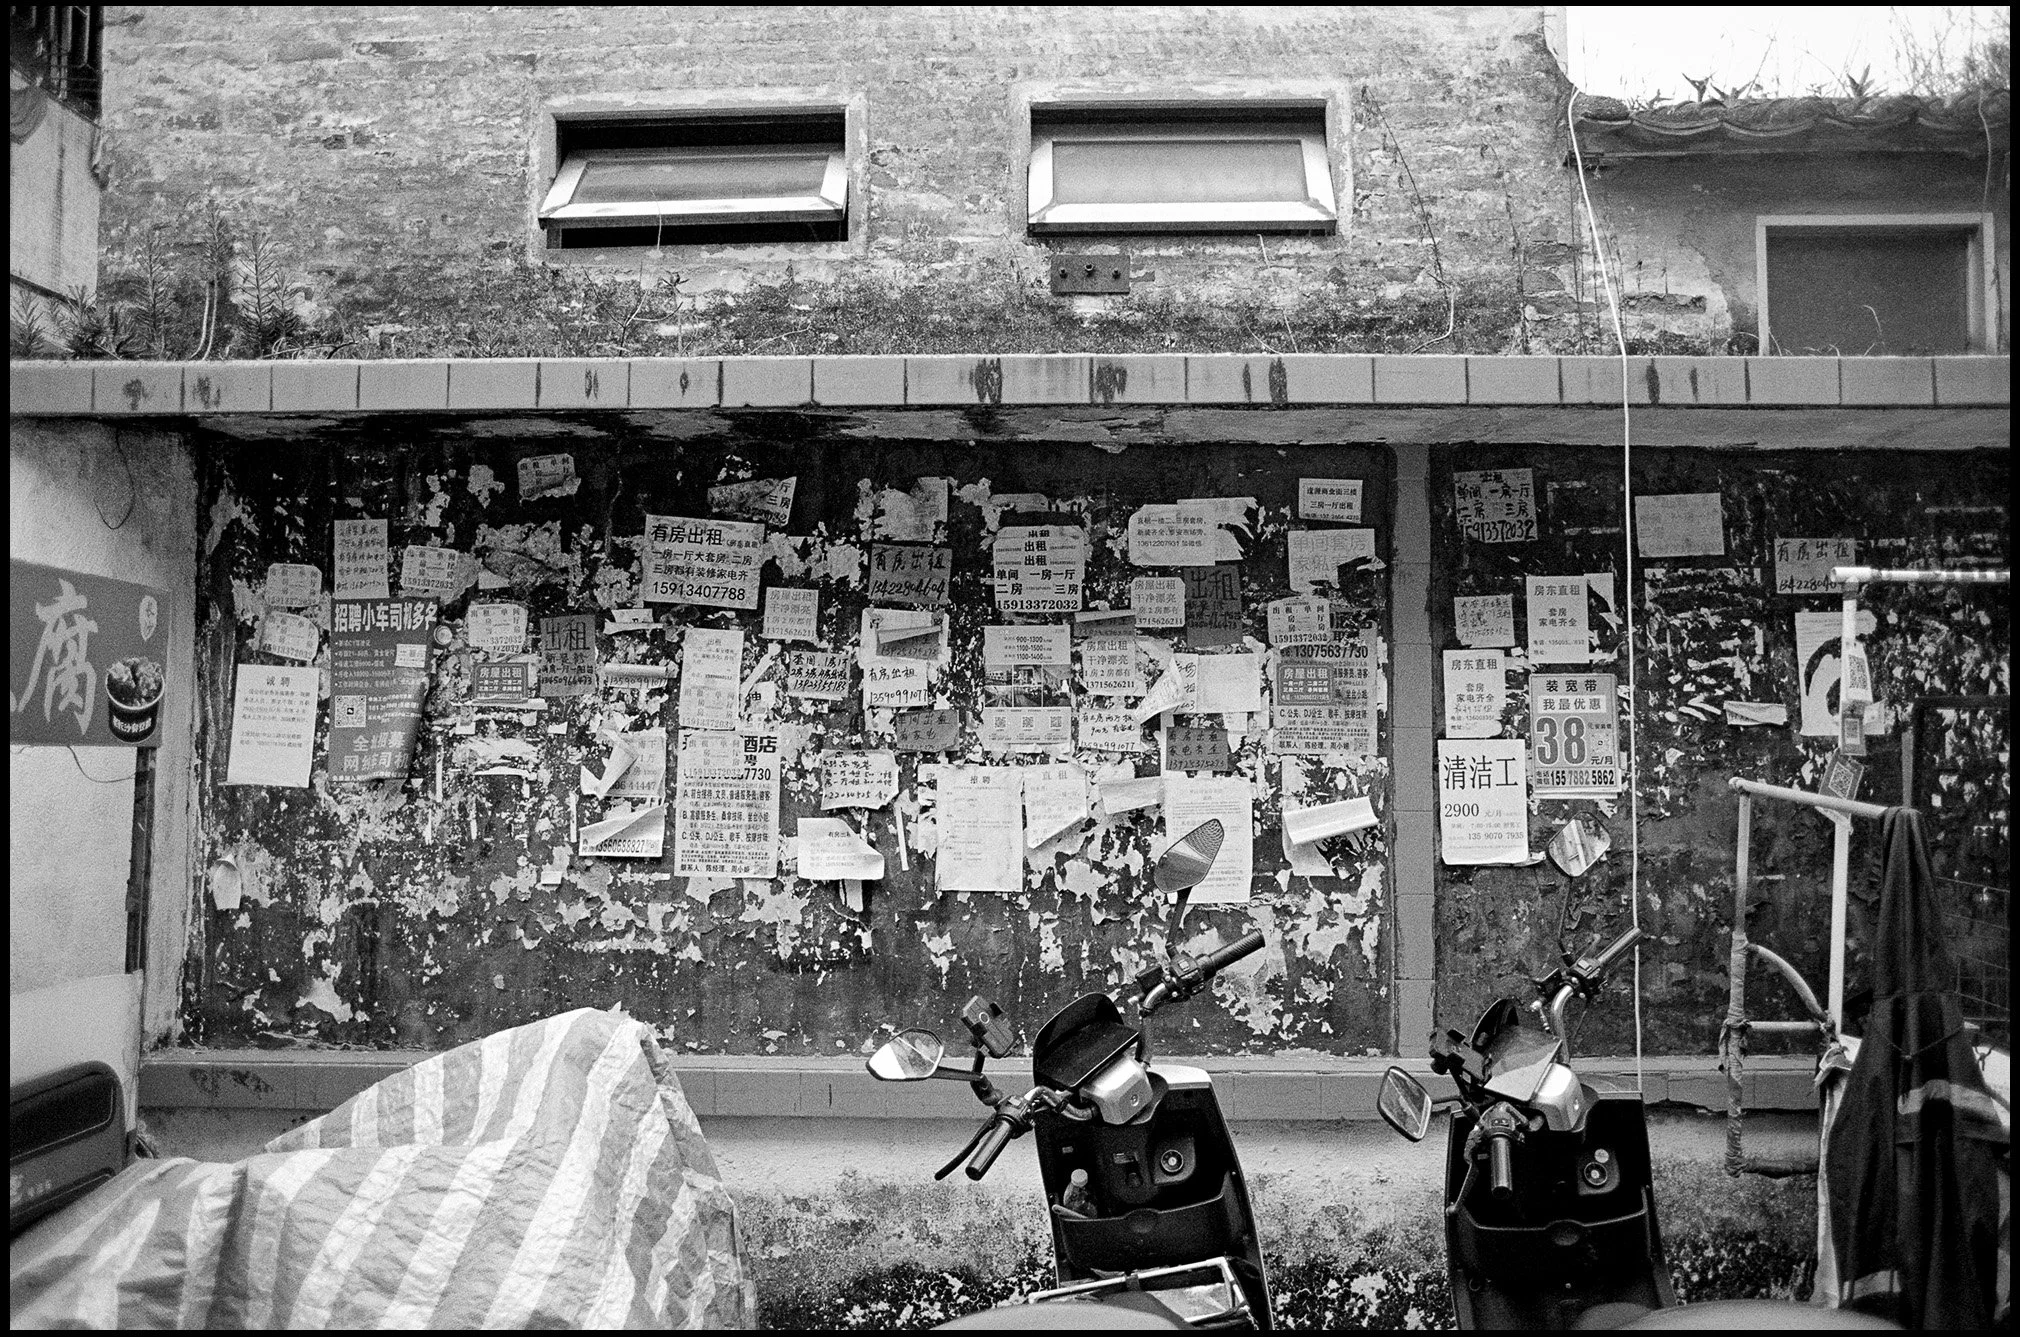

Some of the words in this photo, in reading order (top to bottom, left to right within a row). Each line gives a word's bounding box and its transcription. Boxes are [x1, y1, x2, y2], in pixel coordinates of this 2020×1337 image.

[651, 524, 723, 546] 有房出租
[1024, 541, 1047, 552] 出租
[652, 549, 727, 564] 一房一厅大套房
[732, 555, 752, 566] 二房
[1024, 555, 1047, 566] 出租
[653, 564, 749, 581] 三房都有装修家电齐
[996, 569, 1019, 580] 单间
[1029, 569, 1076, 580] 一房一厅
[996, 583, 1023, 595] 二房
[1054, 584, 1079, 595] 三房
[1135, 580, 1177, 590] 房屋出租
[1534, 585, 1581, 596] 房东直租
[652, 581, 747, 601] 15913407788
[996, 600, 1079, 610] 15913372032
[334, 602, 438, 632] 招聘小车司机多名
[1549, 608, 1567, 617] 套房
[1538, 617, 1578, 627] 家电齐全
[1086, 641, 1128, 651] 房屋出租
[1087, 654, 1129, 665] 干净漂亮
[1451, 658, 1498, 671] 房东直租
[480, 667, 522, 678] 房屋出租
[869, 667, 917, 682] 有房出租
[1284, 668, 1329, 679] 房屋出租
[1085, 681, 1135, 689] 13715626211
[1466, 683, 1484, 693] 套房
[1545, 679, 1598, 692] 装宽带
[870, 689, 928, 704] 13590991077
[1456, 693, 1496, 703] 家电齐全
[1543, 698, 1601, 711] 我最优惠
[743, 736, 778, 753] 酒店
[1536, 716, 1586, 766] 38
[1591, 755, 1614, 765] 元/月
[1443, 755, 1519, 790] 清洁工
[1550, 770, 1566, 786] 155
[1568, 770, 1590, 786] 7882
[1592, 769, 1615, 785] 5862
[1444, 803, 1480, 818] 2900
[1468, 832, 1482, 840] 135
[1484, 832, 1503, 840] 9070
[1505, 831, 1524, 840] 7935
